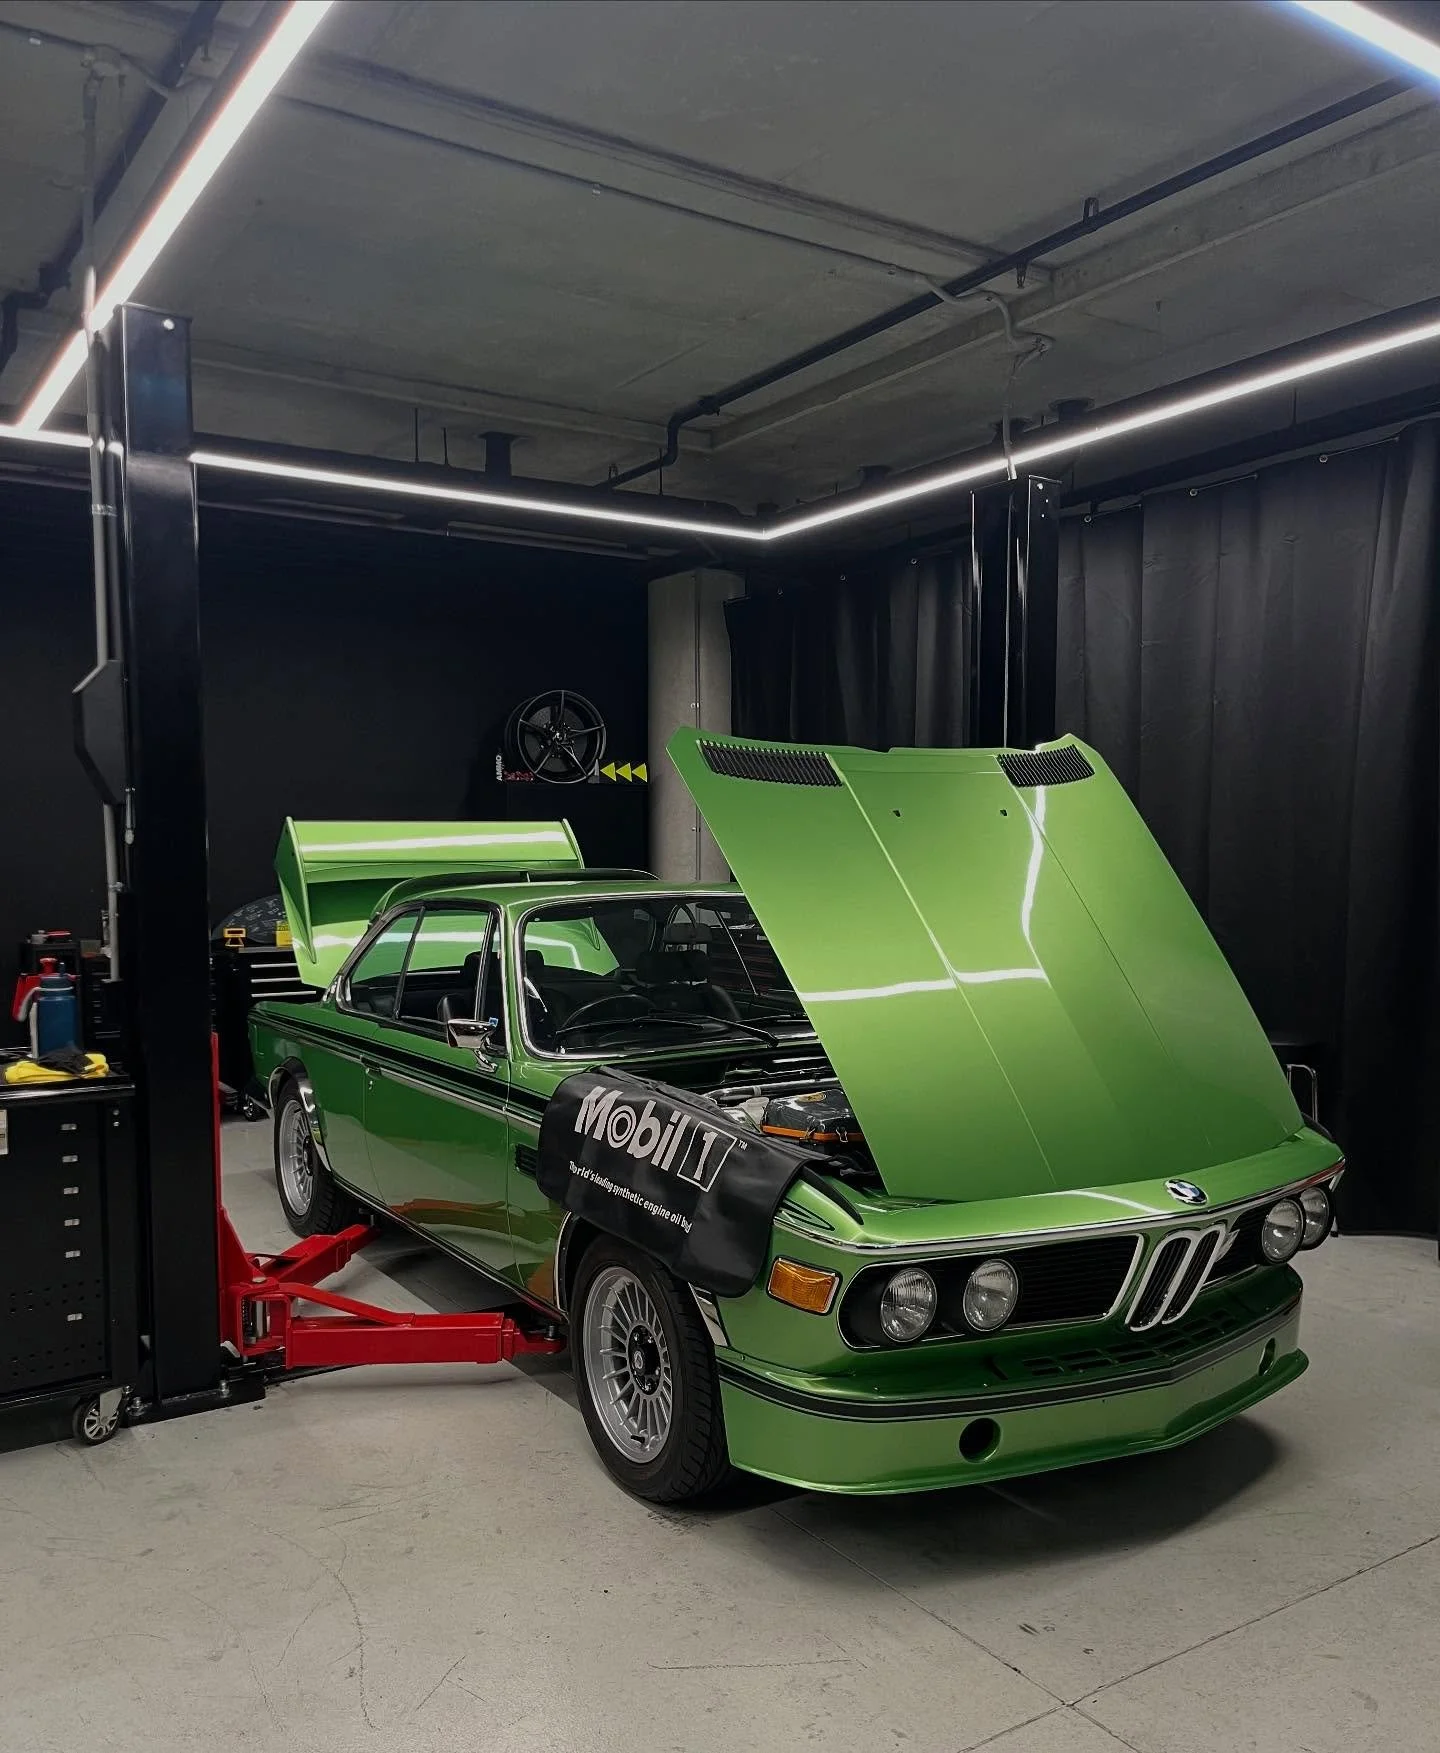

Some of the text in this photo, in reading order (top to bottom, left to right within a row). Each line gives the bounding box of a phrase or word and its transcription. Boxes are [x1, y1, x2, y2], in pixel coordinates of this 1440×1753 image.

[574, 1086, 691, 1171] Mobil
[612, 1185, 644, 1206] synthetic
[643, 1200, 671, 1219] engine
[670, 1213, 682, 1225] oil
